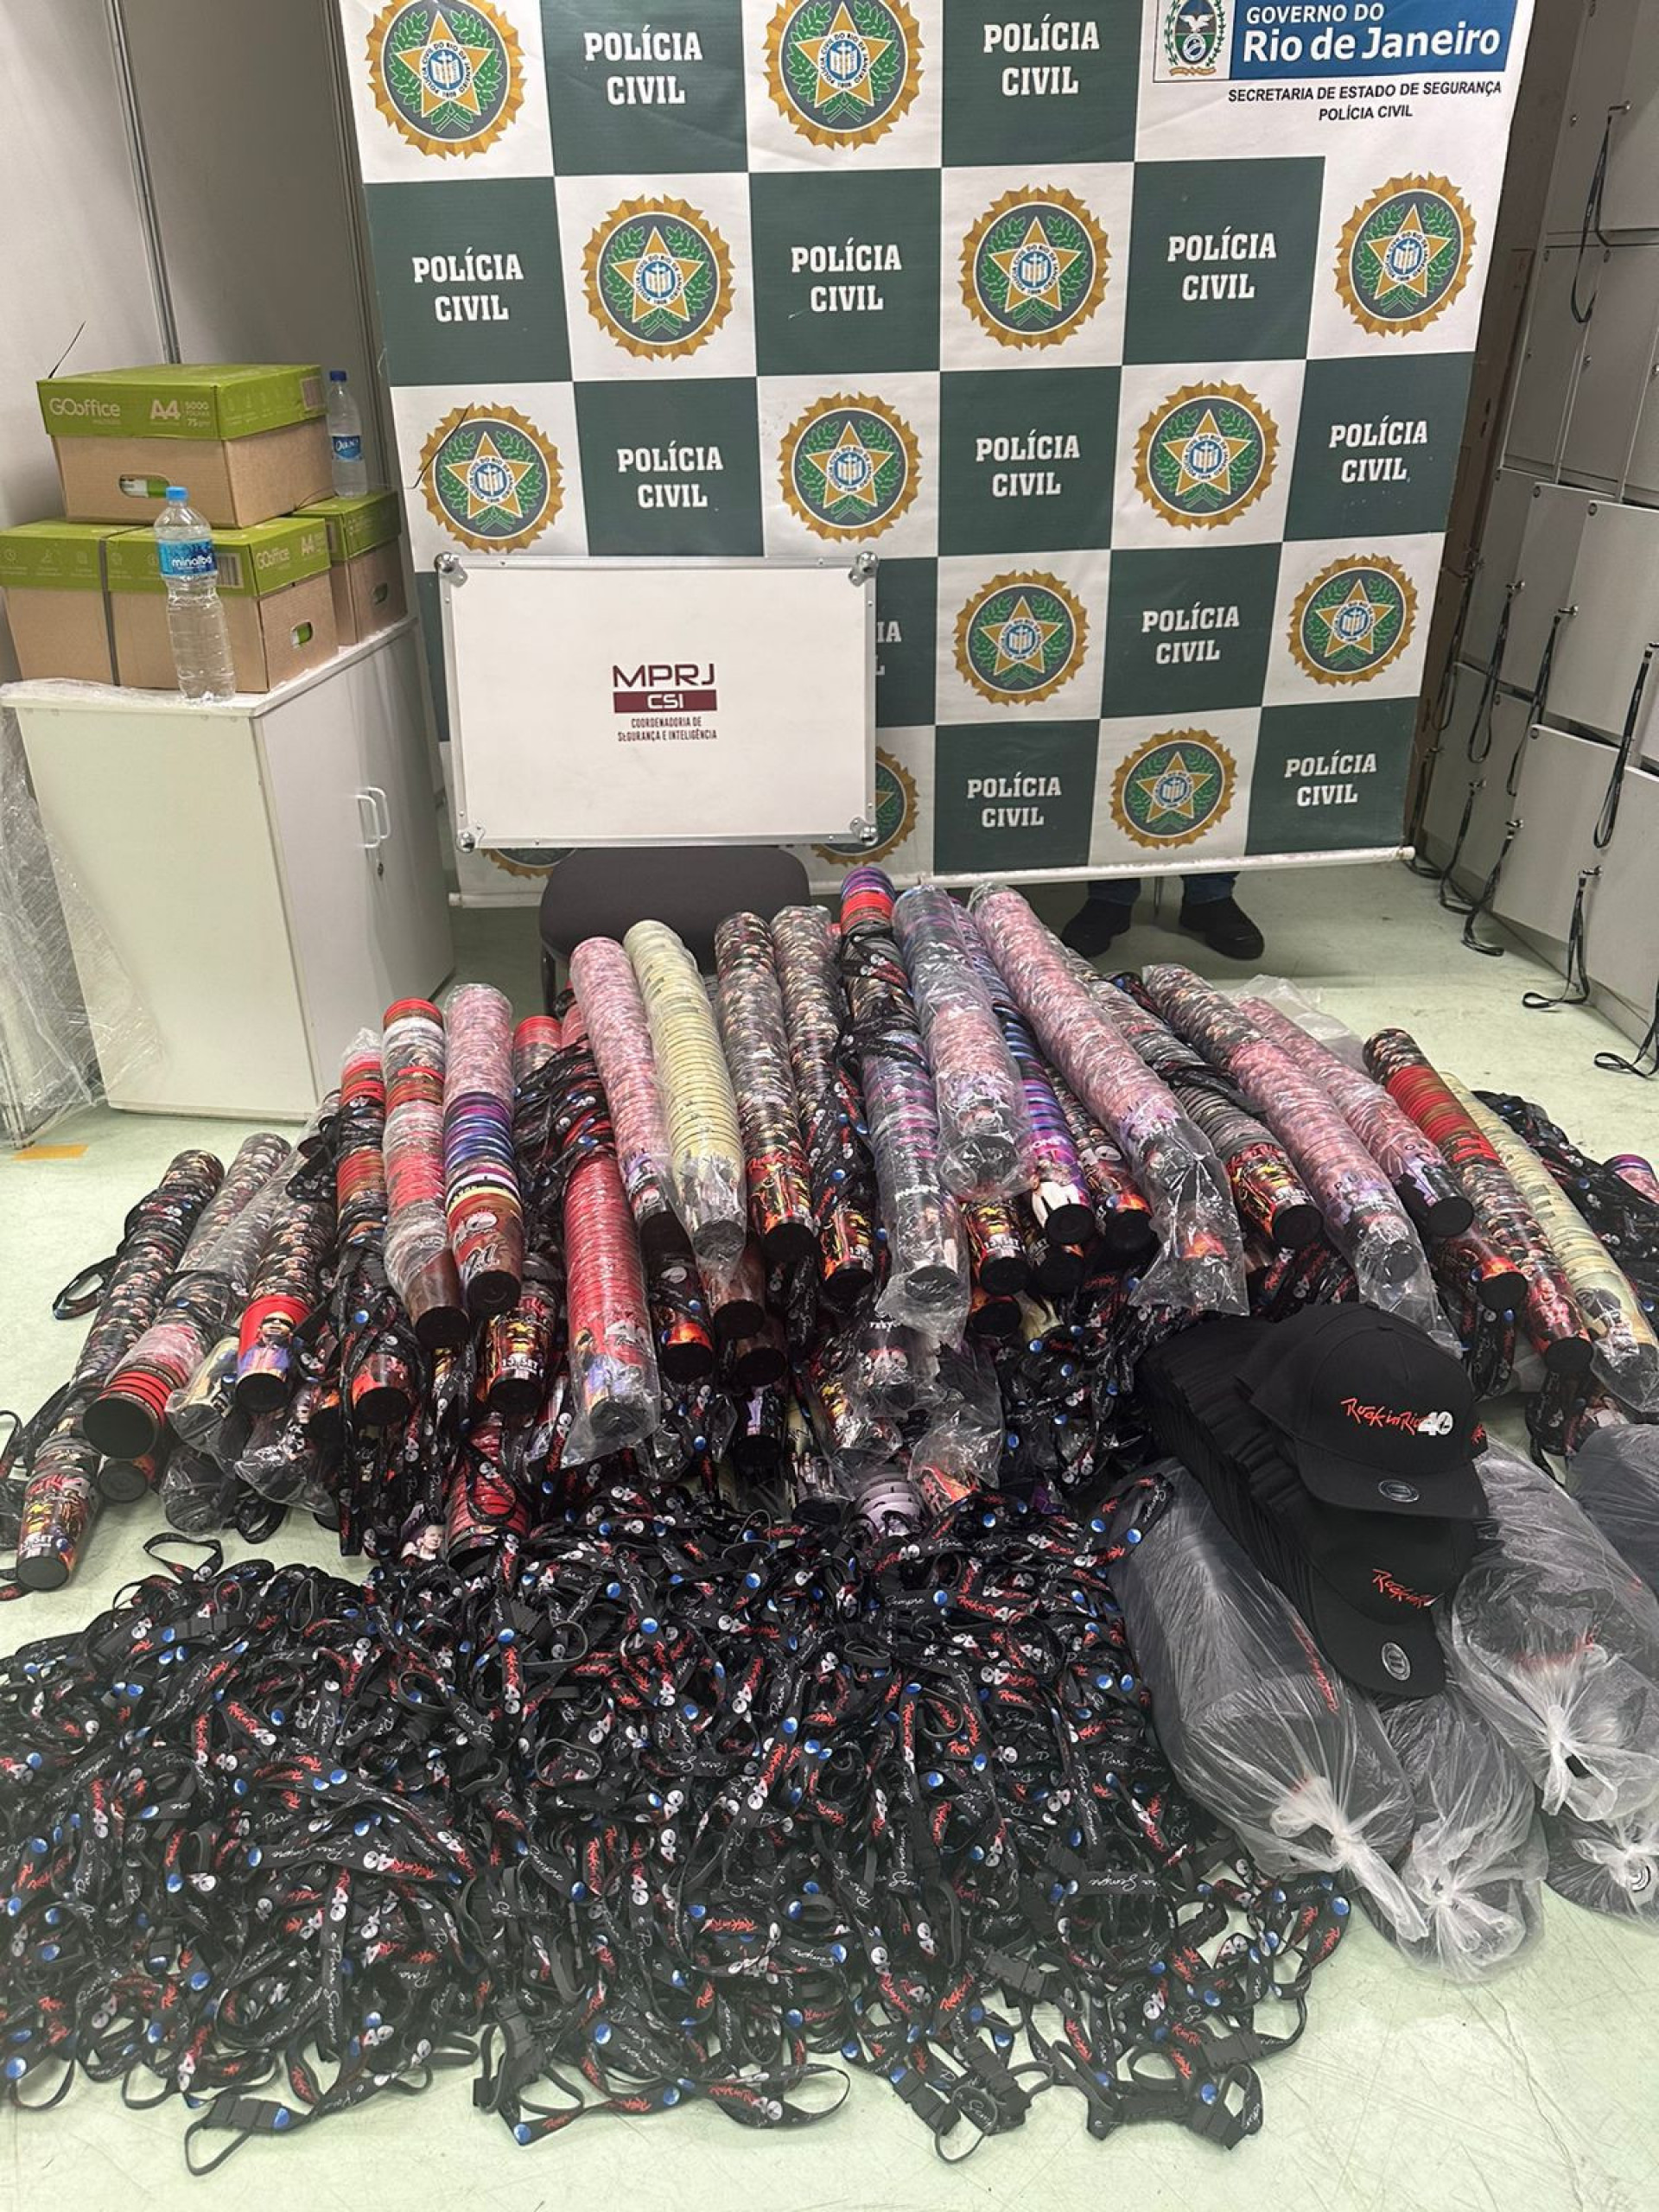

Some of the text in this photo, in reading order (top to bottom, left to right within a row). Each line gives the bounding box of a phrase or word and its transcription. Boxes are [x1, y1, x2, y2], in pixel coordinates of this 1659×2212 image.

[1247, 3, 1384, 24] GOVERNO DO
[584, 25, 702, 60] POLÍCIA
[984, 14, 1099, 53] POLÍCIA
[1244, 21, 1501, 61] Rio de Janeiro
[607, 76, 684, 105] CIVIL
[1002, 67, 1078, 96] CIVIL
[1228, 80, 1502, 102] SECRETARIA DE ESTADO DE SEGURANÇA
[1319, 105, 1414, 122] POLÍCIA CIVIL
[791, 238, 901, 272] POLÍCIA
[1168, 226, 1276, 261] POLÍCIA
[412, 247, 524, 283] POLÍCIA
[811, 285, 883, 311] CIVIL
[1183, 274, 1255, 300] CIVIL
[435, 295, 509, 321] CIVIL
[150, 399, 181, 420] A4
[1330, 415, 1427, 448] POLÍCIA
[618, 441, 723, 472] POLÍCIA
[976, 429, 1079, 461] POLÍCIA
[1342, 458, 1407, 482] CIVIL
[639, 484, 708, 507] CIVIL
[993, 473, 1060, 497] CIVIL
[172, 553, 213, 568] minalba
[1142, 601, 1239, 632] POLÍCIA
[1156, 640, 1220, 664] CIVIL
[612, 663, 715, 688] MPRJ
[647, 693, 683, 709] CSI
[631, 715, 702, 728] COORDENADORIA DE
[662, 730, 666, 741] E
[668, 728, 717, 741] INTELIGÊNCIA
[1285, 750, 1376, 778] POLÍCIA
[968, 772, 1061, 798] POLÍCIA
[1297, 784, 1357, 806] CIVIL
[982, 807, 1044, 827] CIVIL
[1341, 1397, 1386, 1427] Rock
[1417, 1411, 1453, 1436] 40
